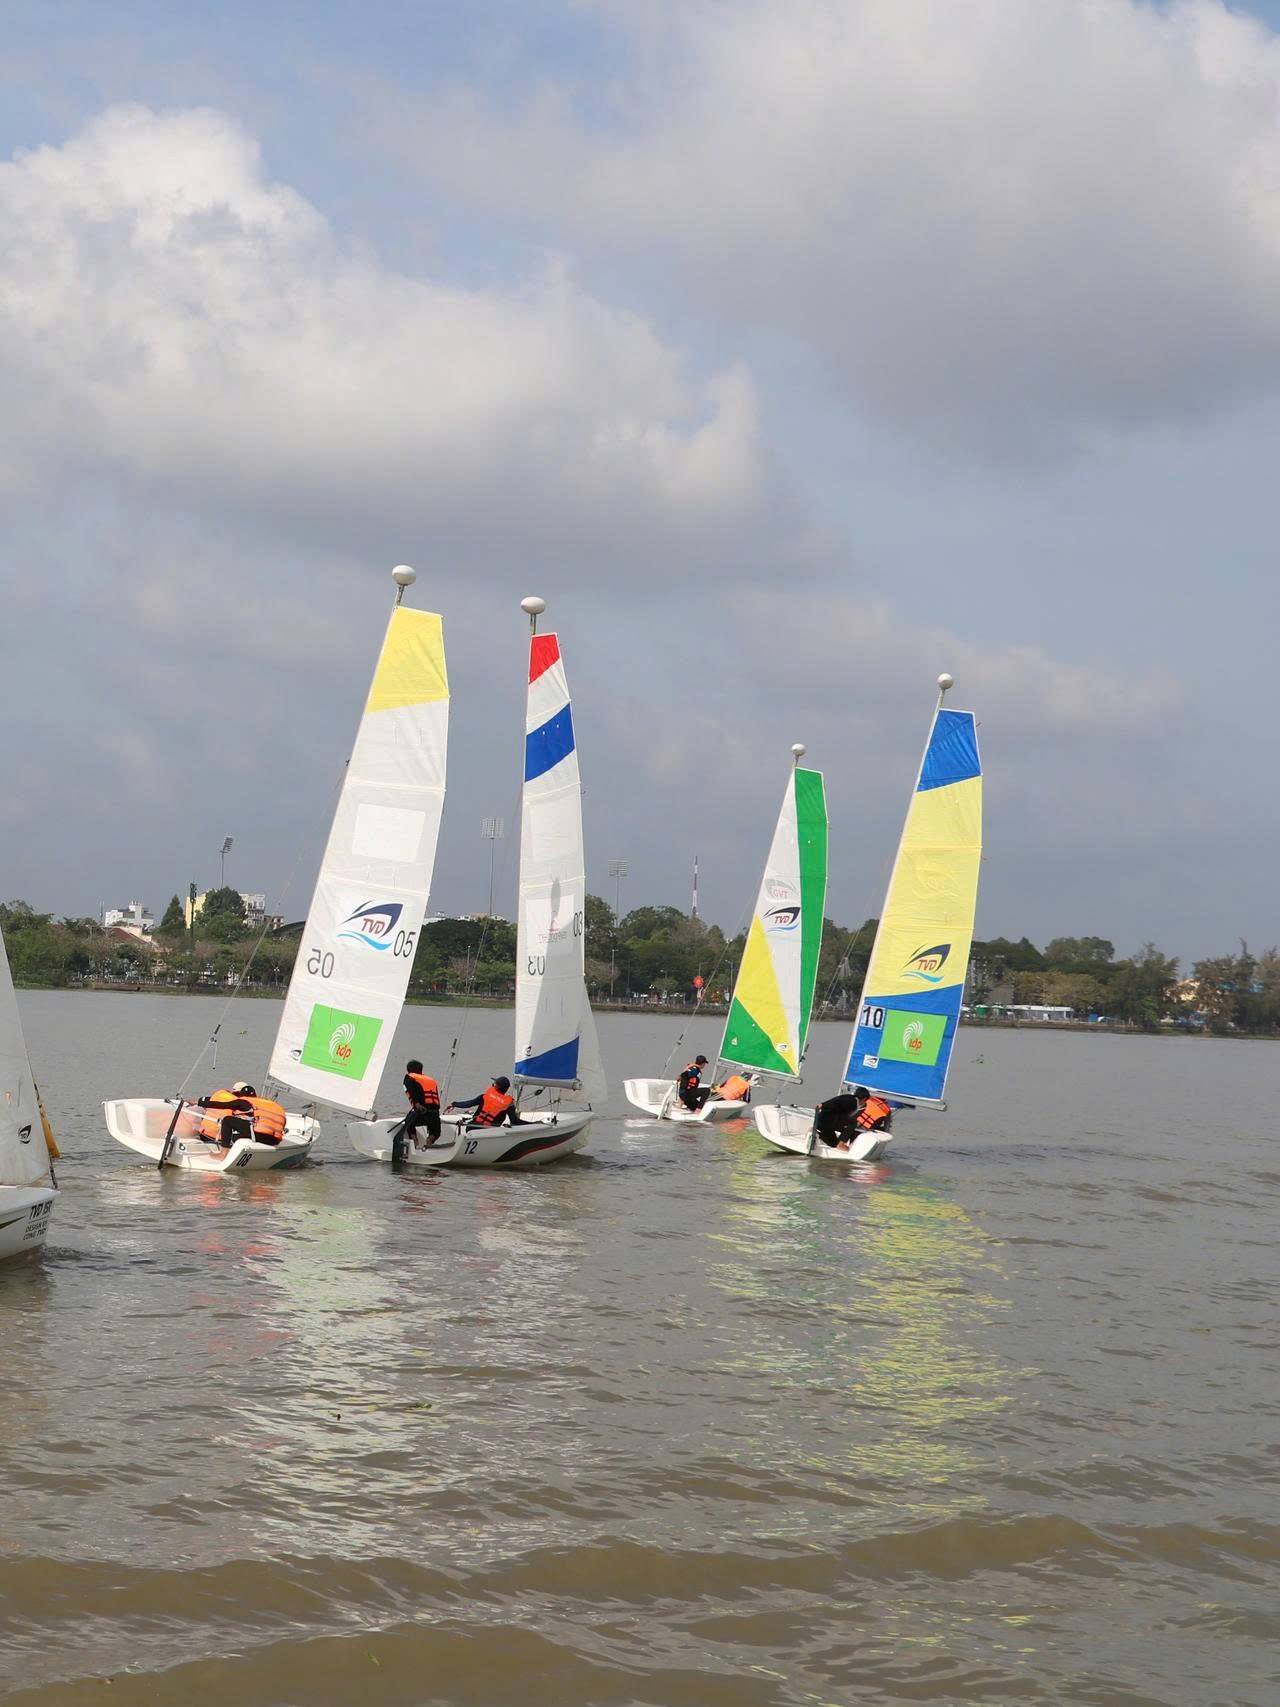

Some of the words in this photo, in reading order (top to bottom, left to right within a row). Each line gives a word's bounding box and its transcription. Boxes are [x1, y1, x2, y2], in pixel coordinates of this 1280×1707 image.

[361, 918, 385, 935] TVD
[774, 915, 790, 924] TVD
[393, 930, 416, 958] 05
[918, 959, 937, 971] TVD
[863, 1006, 884, 1028] 10
[464, 1140, 478, 1155] 12
[236, 1153, 253, 1167] 08
